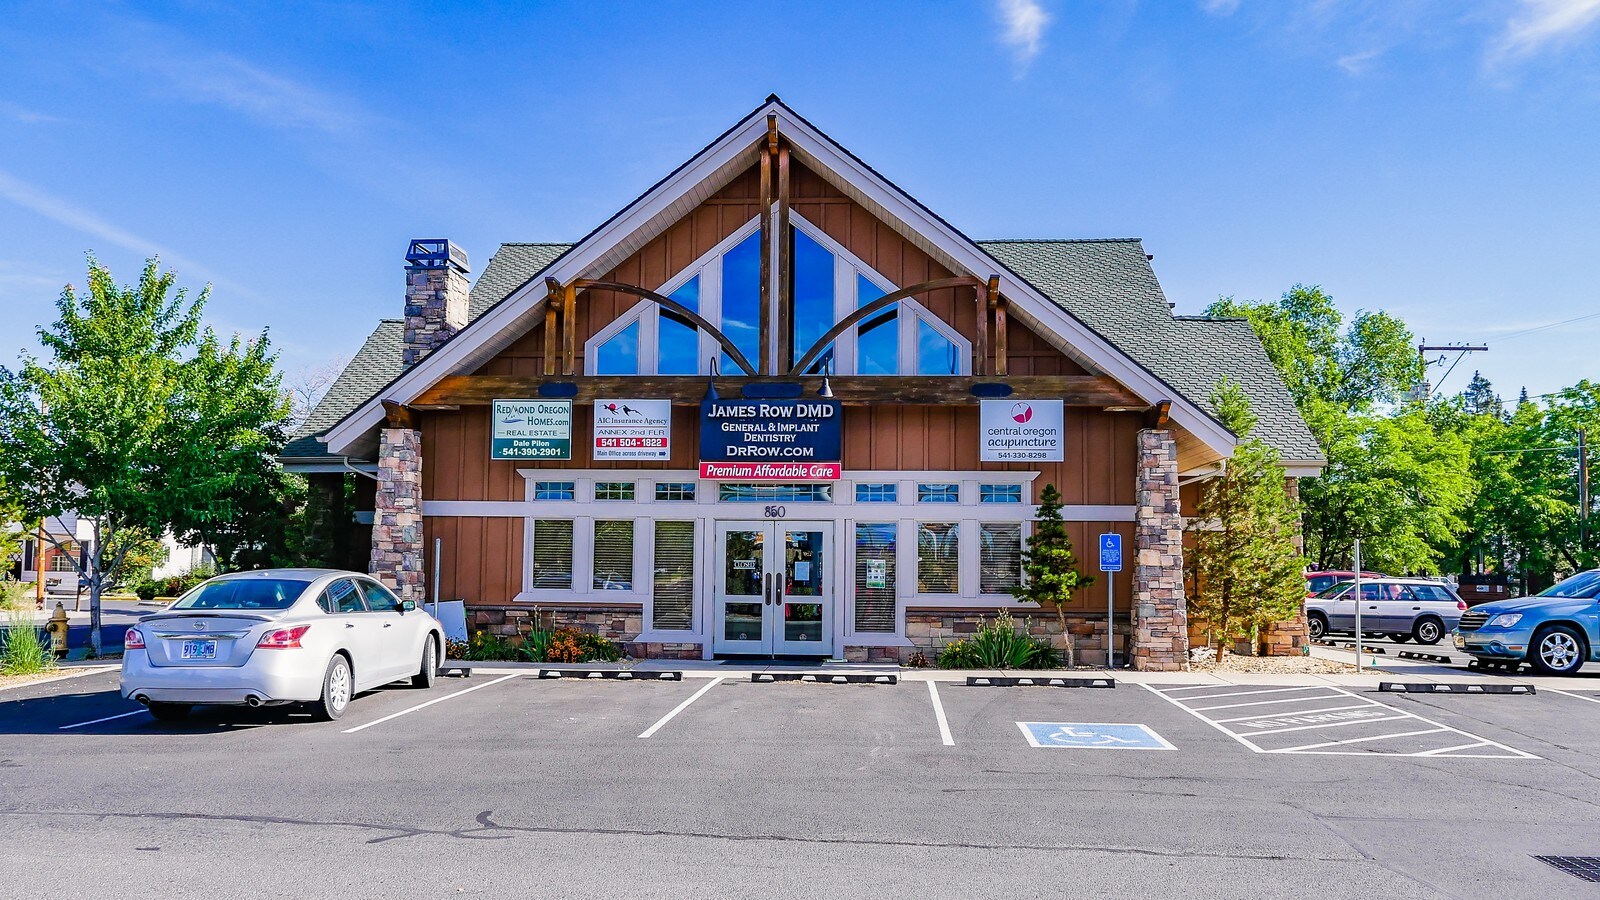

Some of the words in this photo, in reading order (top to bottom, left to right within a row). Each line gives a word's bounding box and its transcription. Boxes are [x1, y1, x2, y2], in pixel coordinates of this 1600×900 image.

[497, 404, 535, 414] REDMOND
[538, 404, 568, 414] OREGON
[708, 404, 756, 418] JAMES
[760, 404, 793, 418] ROW
[796, 404, 834, 418] DMD
[528, 416, 568, 426] HOMES.com
[644, 418, 667, 426] Agency
[722, 422, 766, 432] GENERAL
[768, 422, 776, 432] &
[777, 422, 820, 432] IMPLANT
[744, 433, 796, 442] DENTISTRY
[988, 427, 1021, 436] central
[1022, 428, 1057, 438] oregon
[601, 438, 617, 447] 541
[620, 438, 662, 447] 504-1822
[988, 438, 1056, 449] acupuncture
[706, 465, 752, 476] Premium
[754, 465, 807, 476] Affordable
[810, 465, 833, 476] Care
[764, 506, 786, 518] 850
[184, 645, 197, 654] 919
[200, 645, 214, 654] JMB
